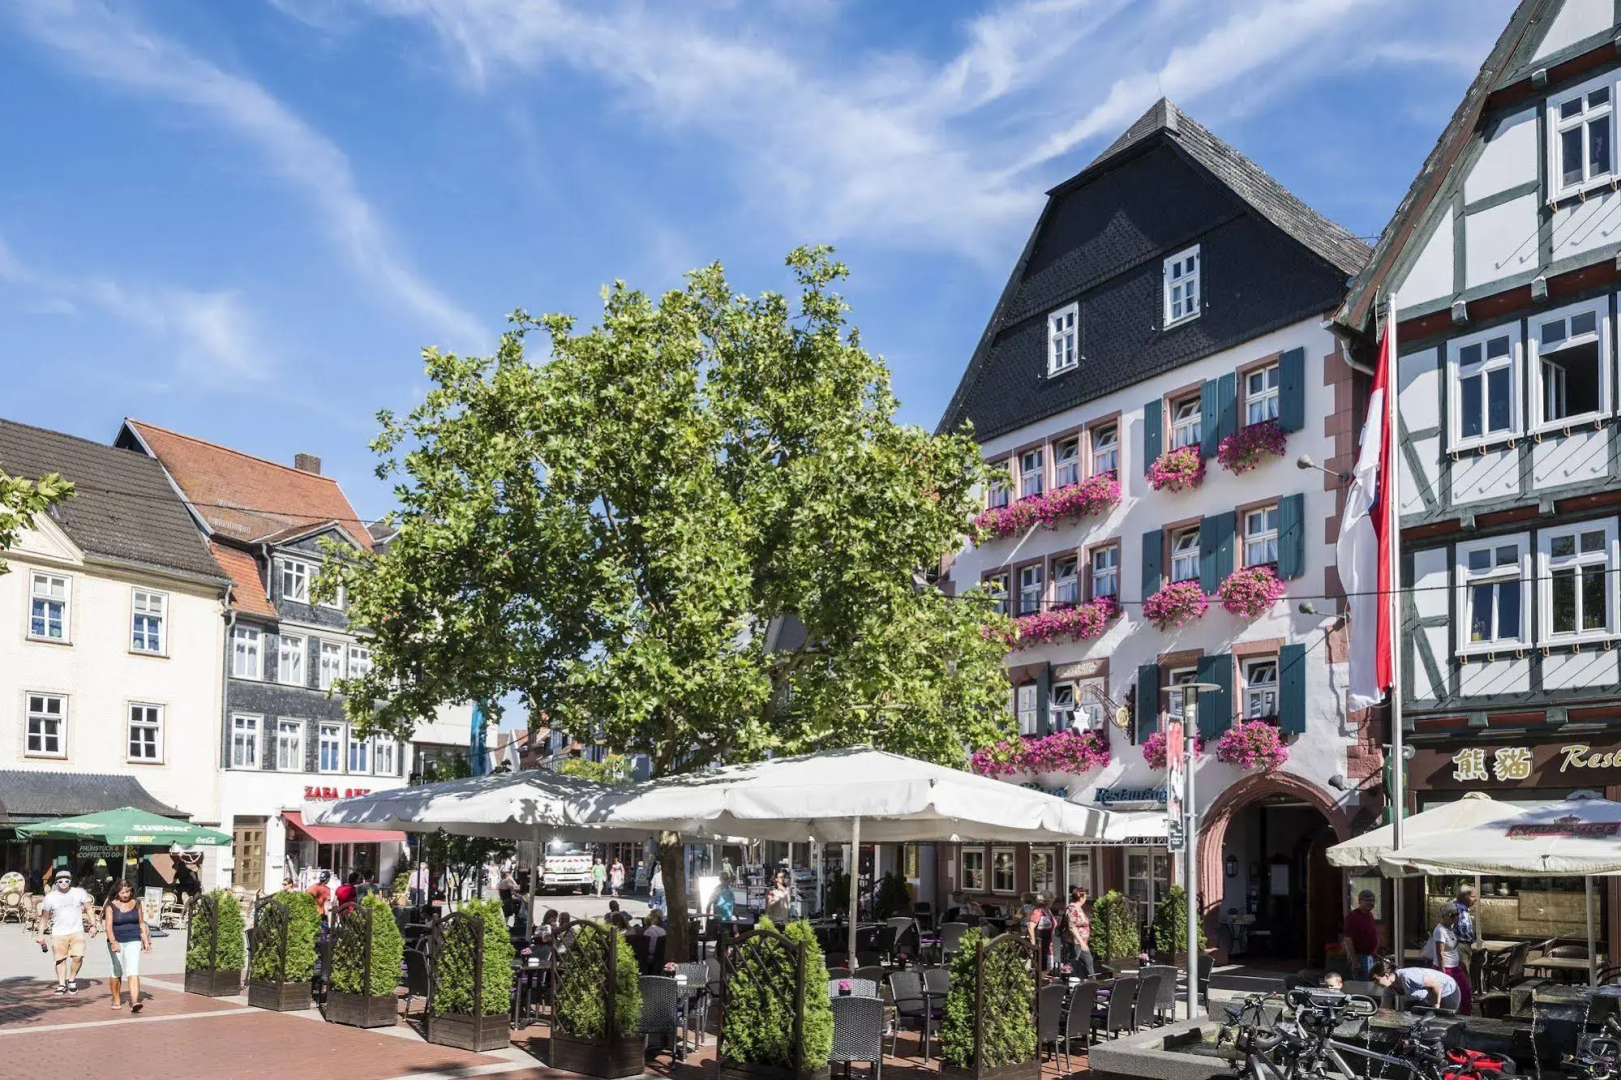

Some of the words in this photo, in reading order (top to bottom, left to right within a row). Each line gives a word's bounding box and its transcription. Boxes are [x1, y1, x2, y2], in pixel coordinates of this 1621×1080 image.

[1452, 747, 1533, 782] 熊貓
[132, 824, 192, 832] SUBWAY
[123, 835, 156, 843] SUBWAY
